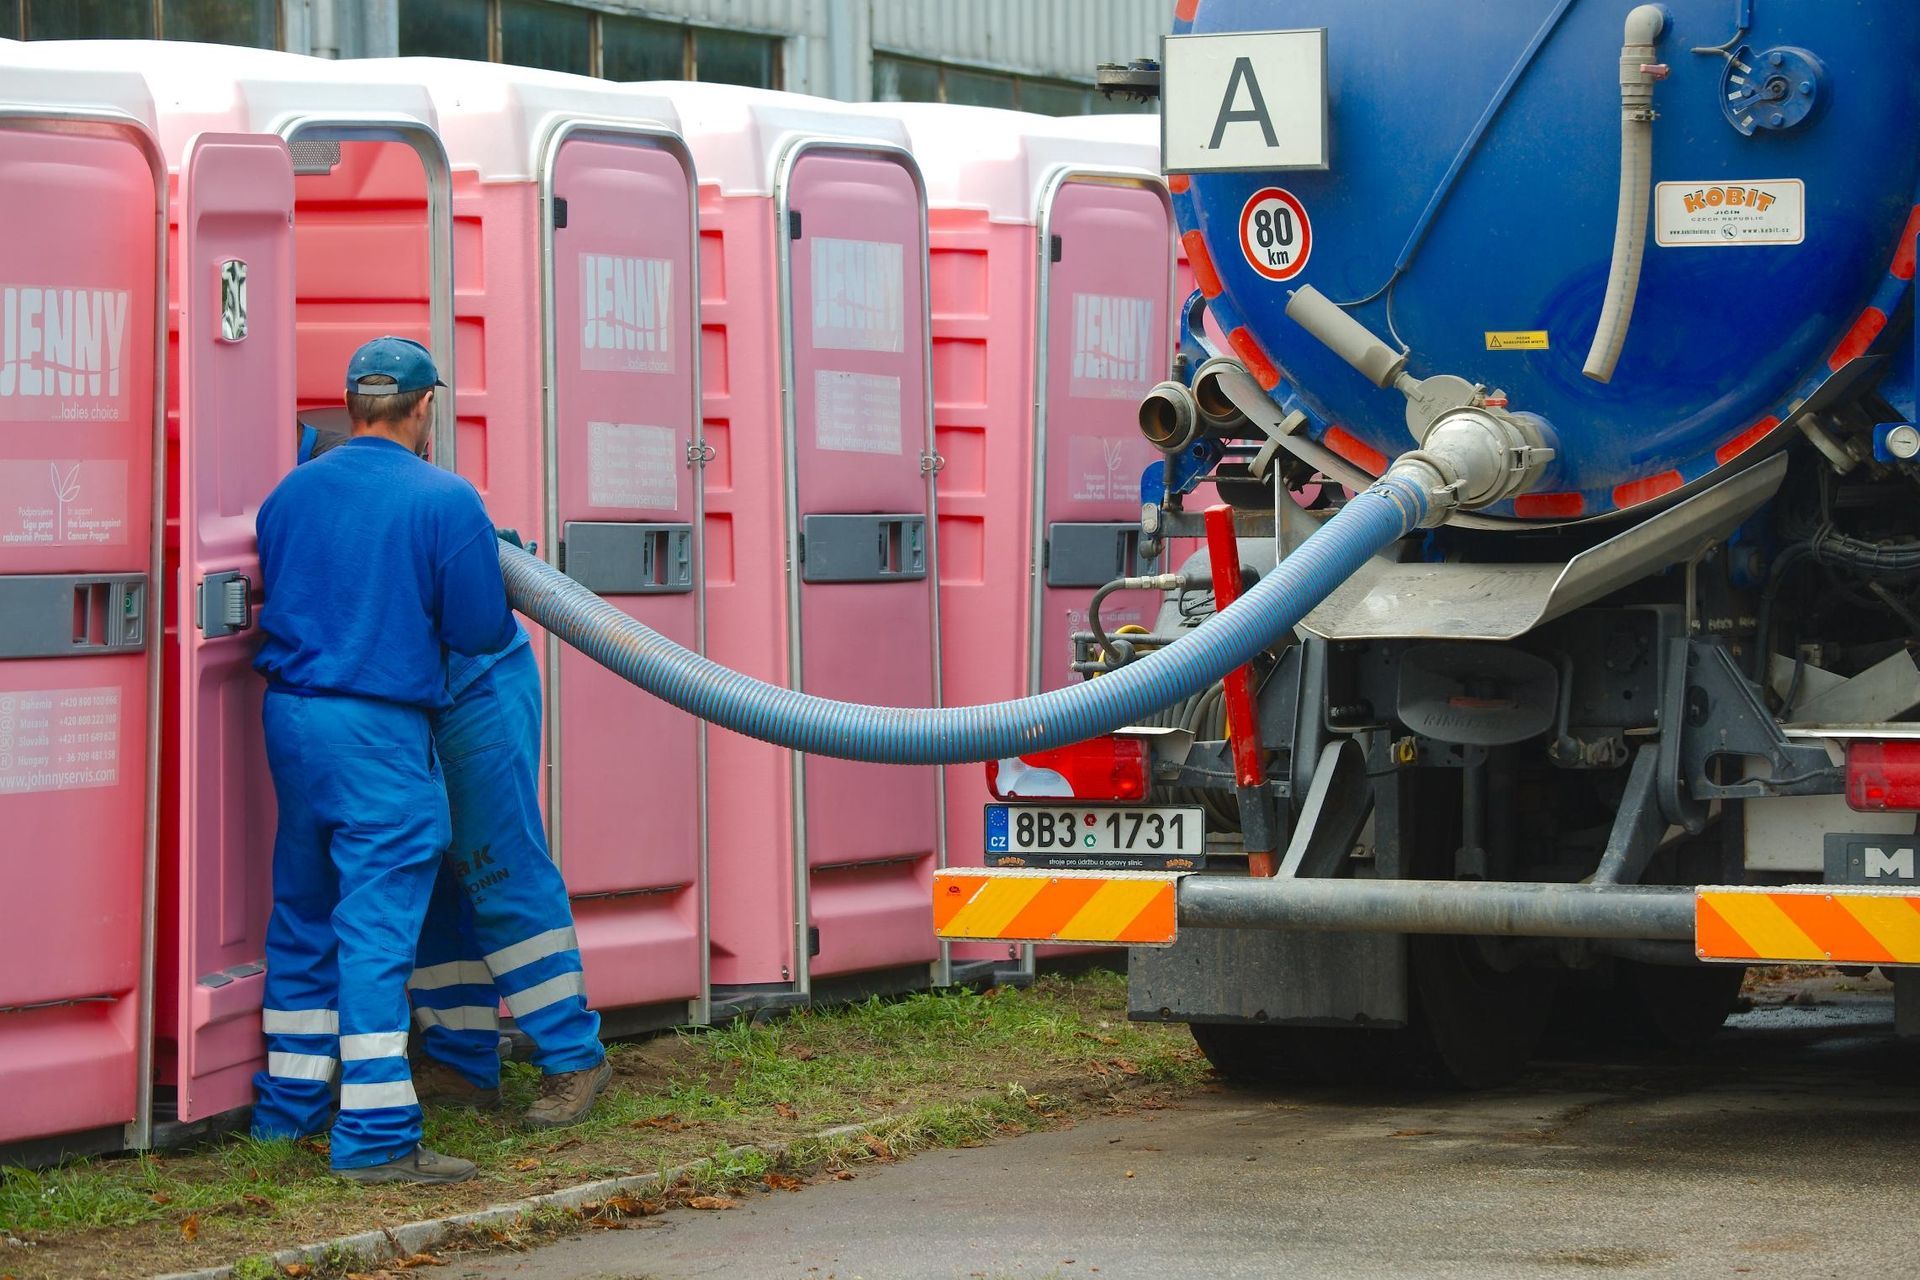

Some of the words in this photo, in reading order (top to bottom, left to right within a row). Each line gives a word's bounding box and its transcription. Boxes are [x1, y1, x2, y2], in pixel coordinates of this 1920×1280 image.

[1208, 57, 1280, 149] A
[1684, 187, 1776, 213] KOBIT
[1255, 207, 1293, 248] 80
[1267, 249, 1289, 265] km
[584, 255, 671, 352] JENNY
[0, 287, 128, 397] JENNY
[1074, 296, 1152, 382] JENNY
[91, 402, 120, 420] choice
[991, 836, 1006, 847] CZ
[1017, 812, 1076, 848] 8B3
[1106, 812, 1183, 849] 1731
[1049, 858, 1065, 866] stroje
[1077, 858, 1098, 866] údržbu
